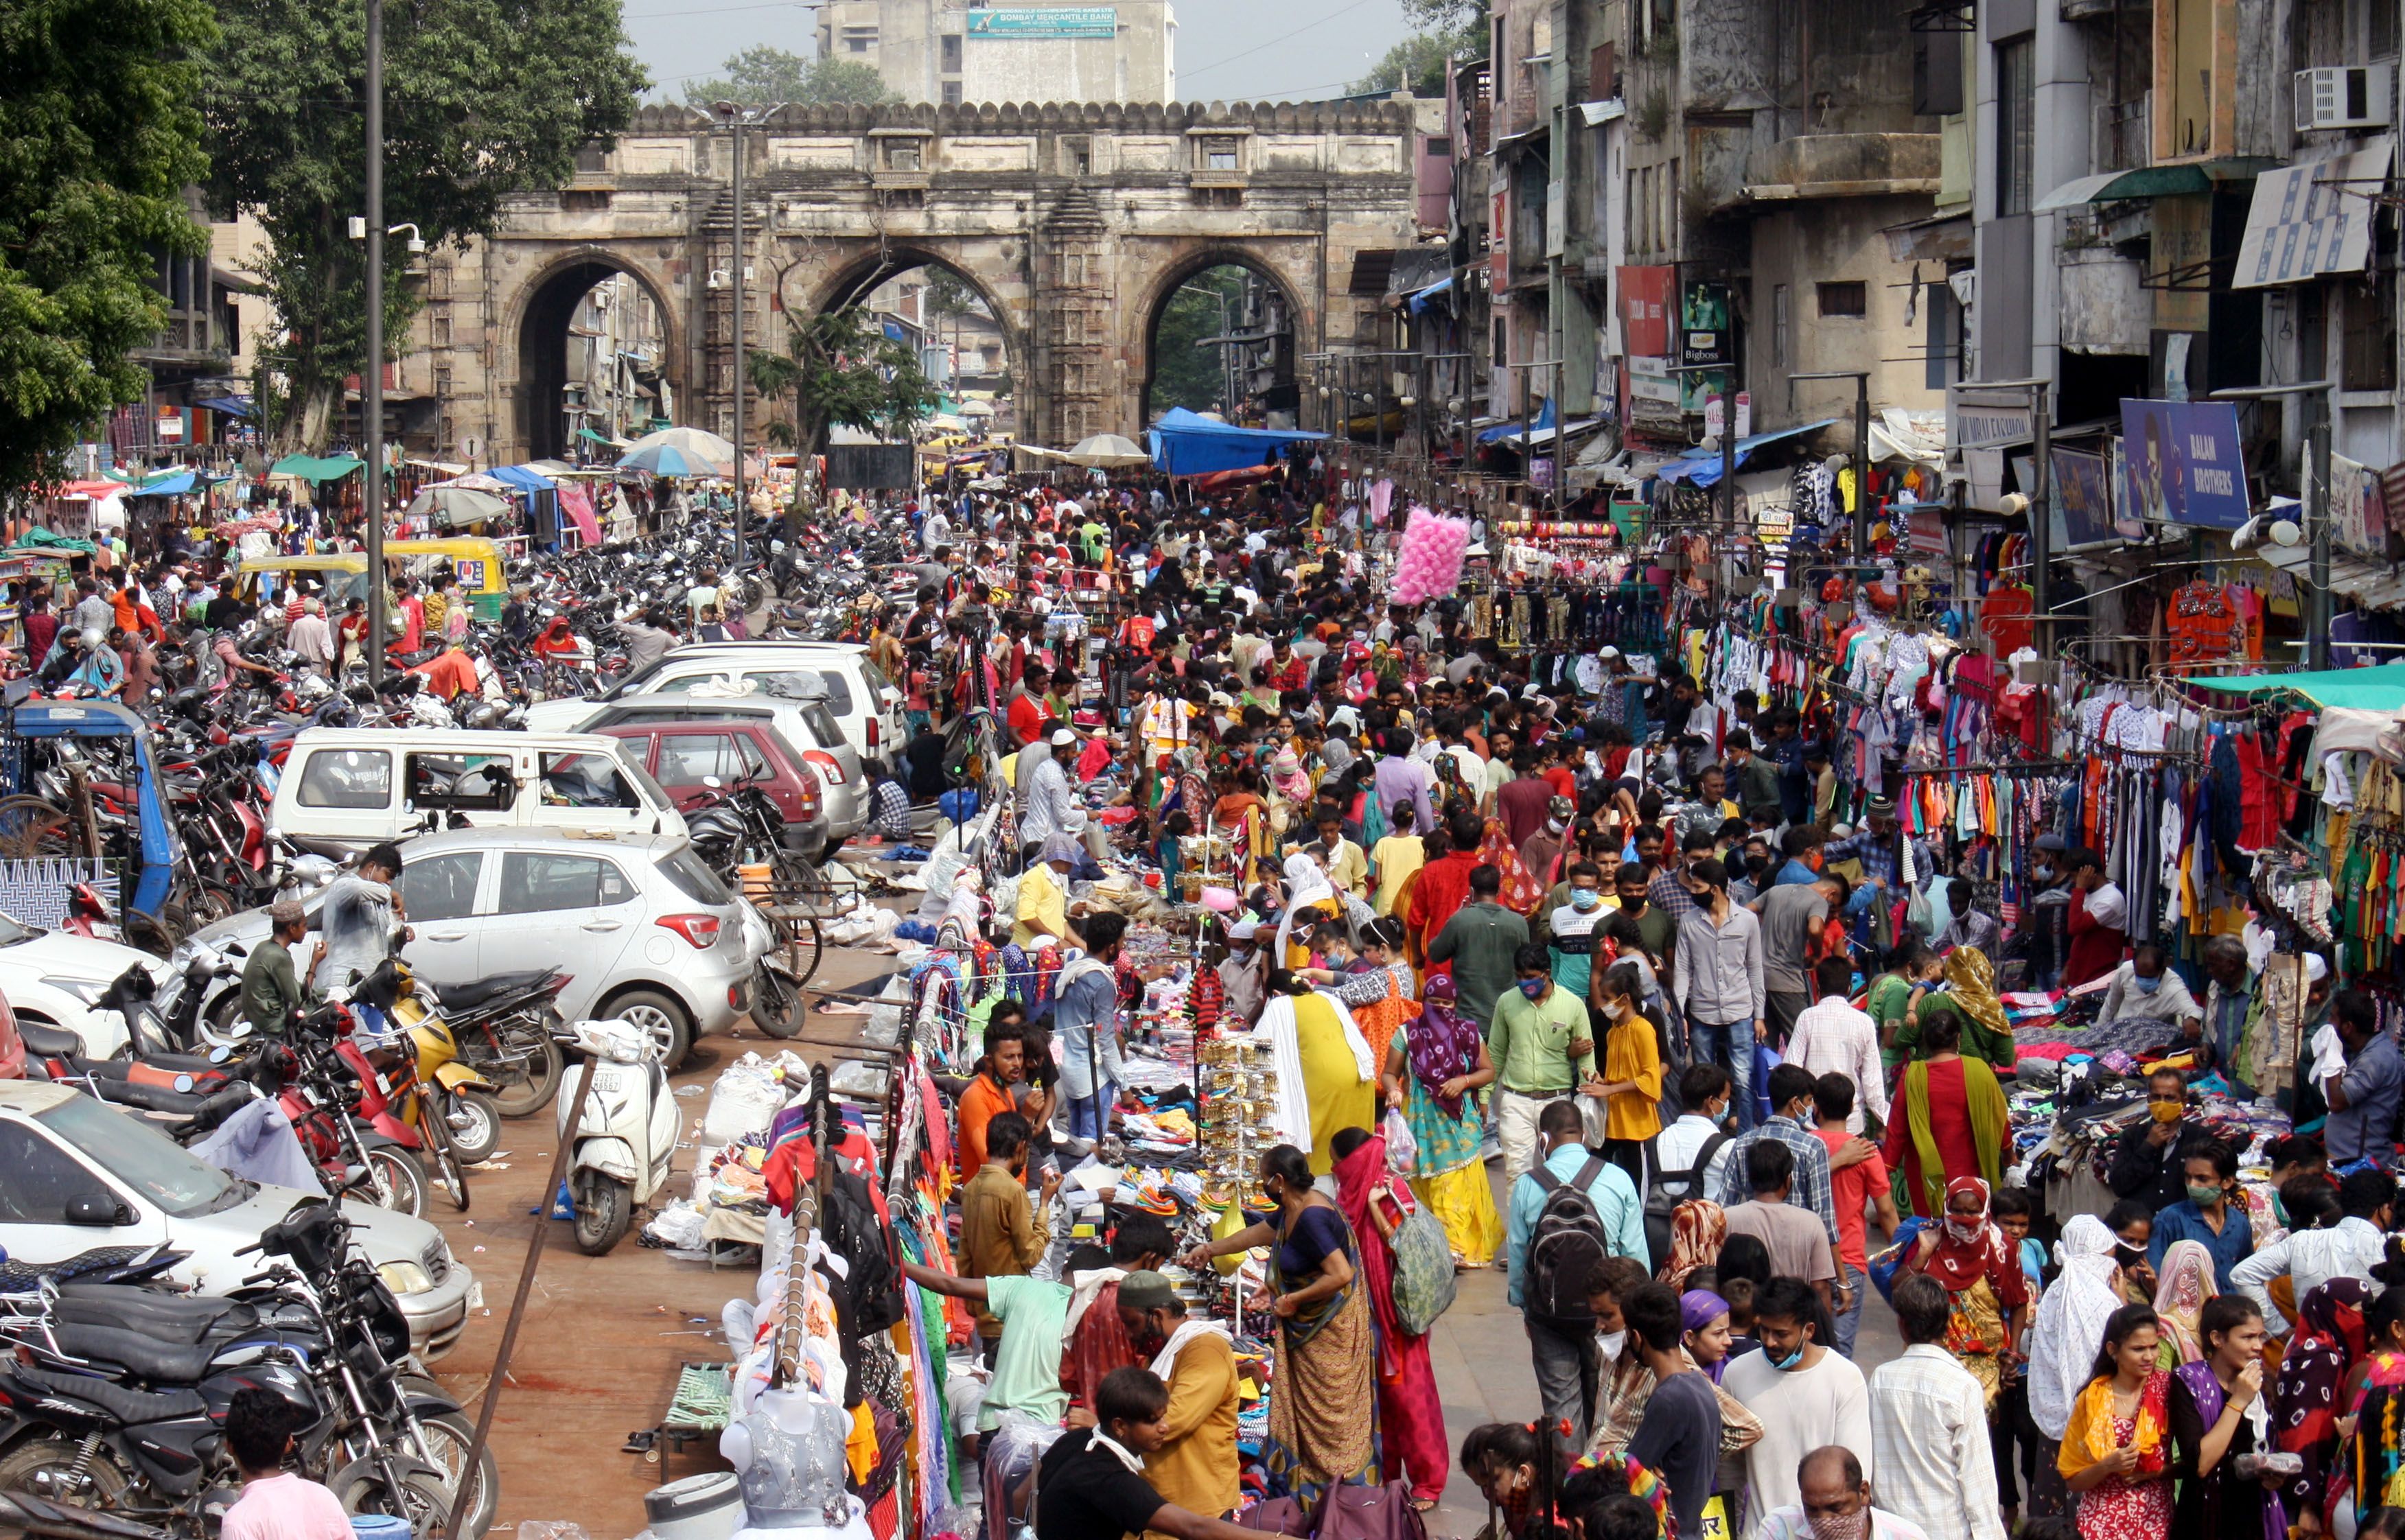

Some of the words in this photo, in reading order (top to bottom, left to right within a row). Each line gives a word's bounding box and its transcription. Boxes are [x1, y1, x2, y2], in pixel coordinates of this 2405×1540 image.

[1685, 349, 1719, 362] Bigboss
[2189, 434, 2217, 461] BALAM
[2194, 467, 2233, 496] BROTHERS
